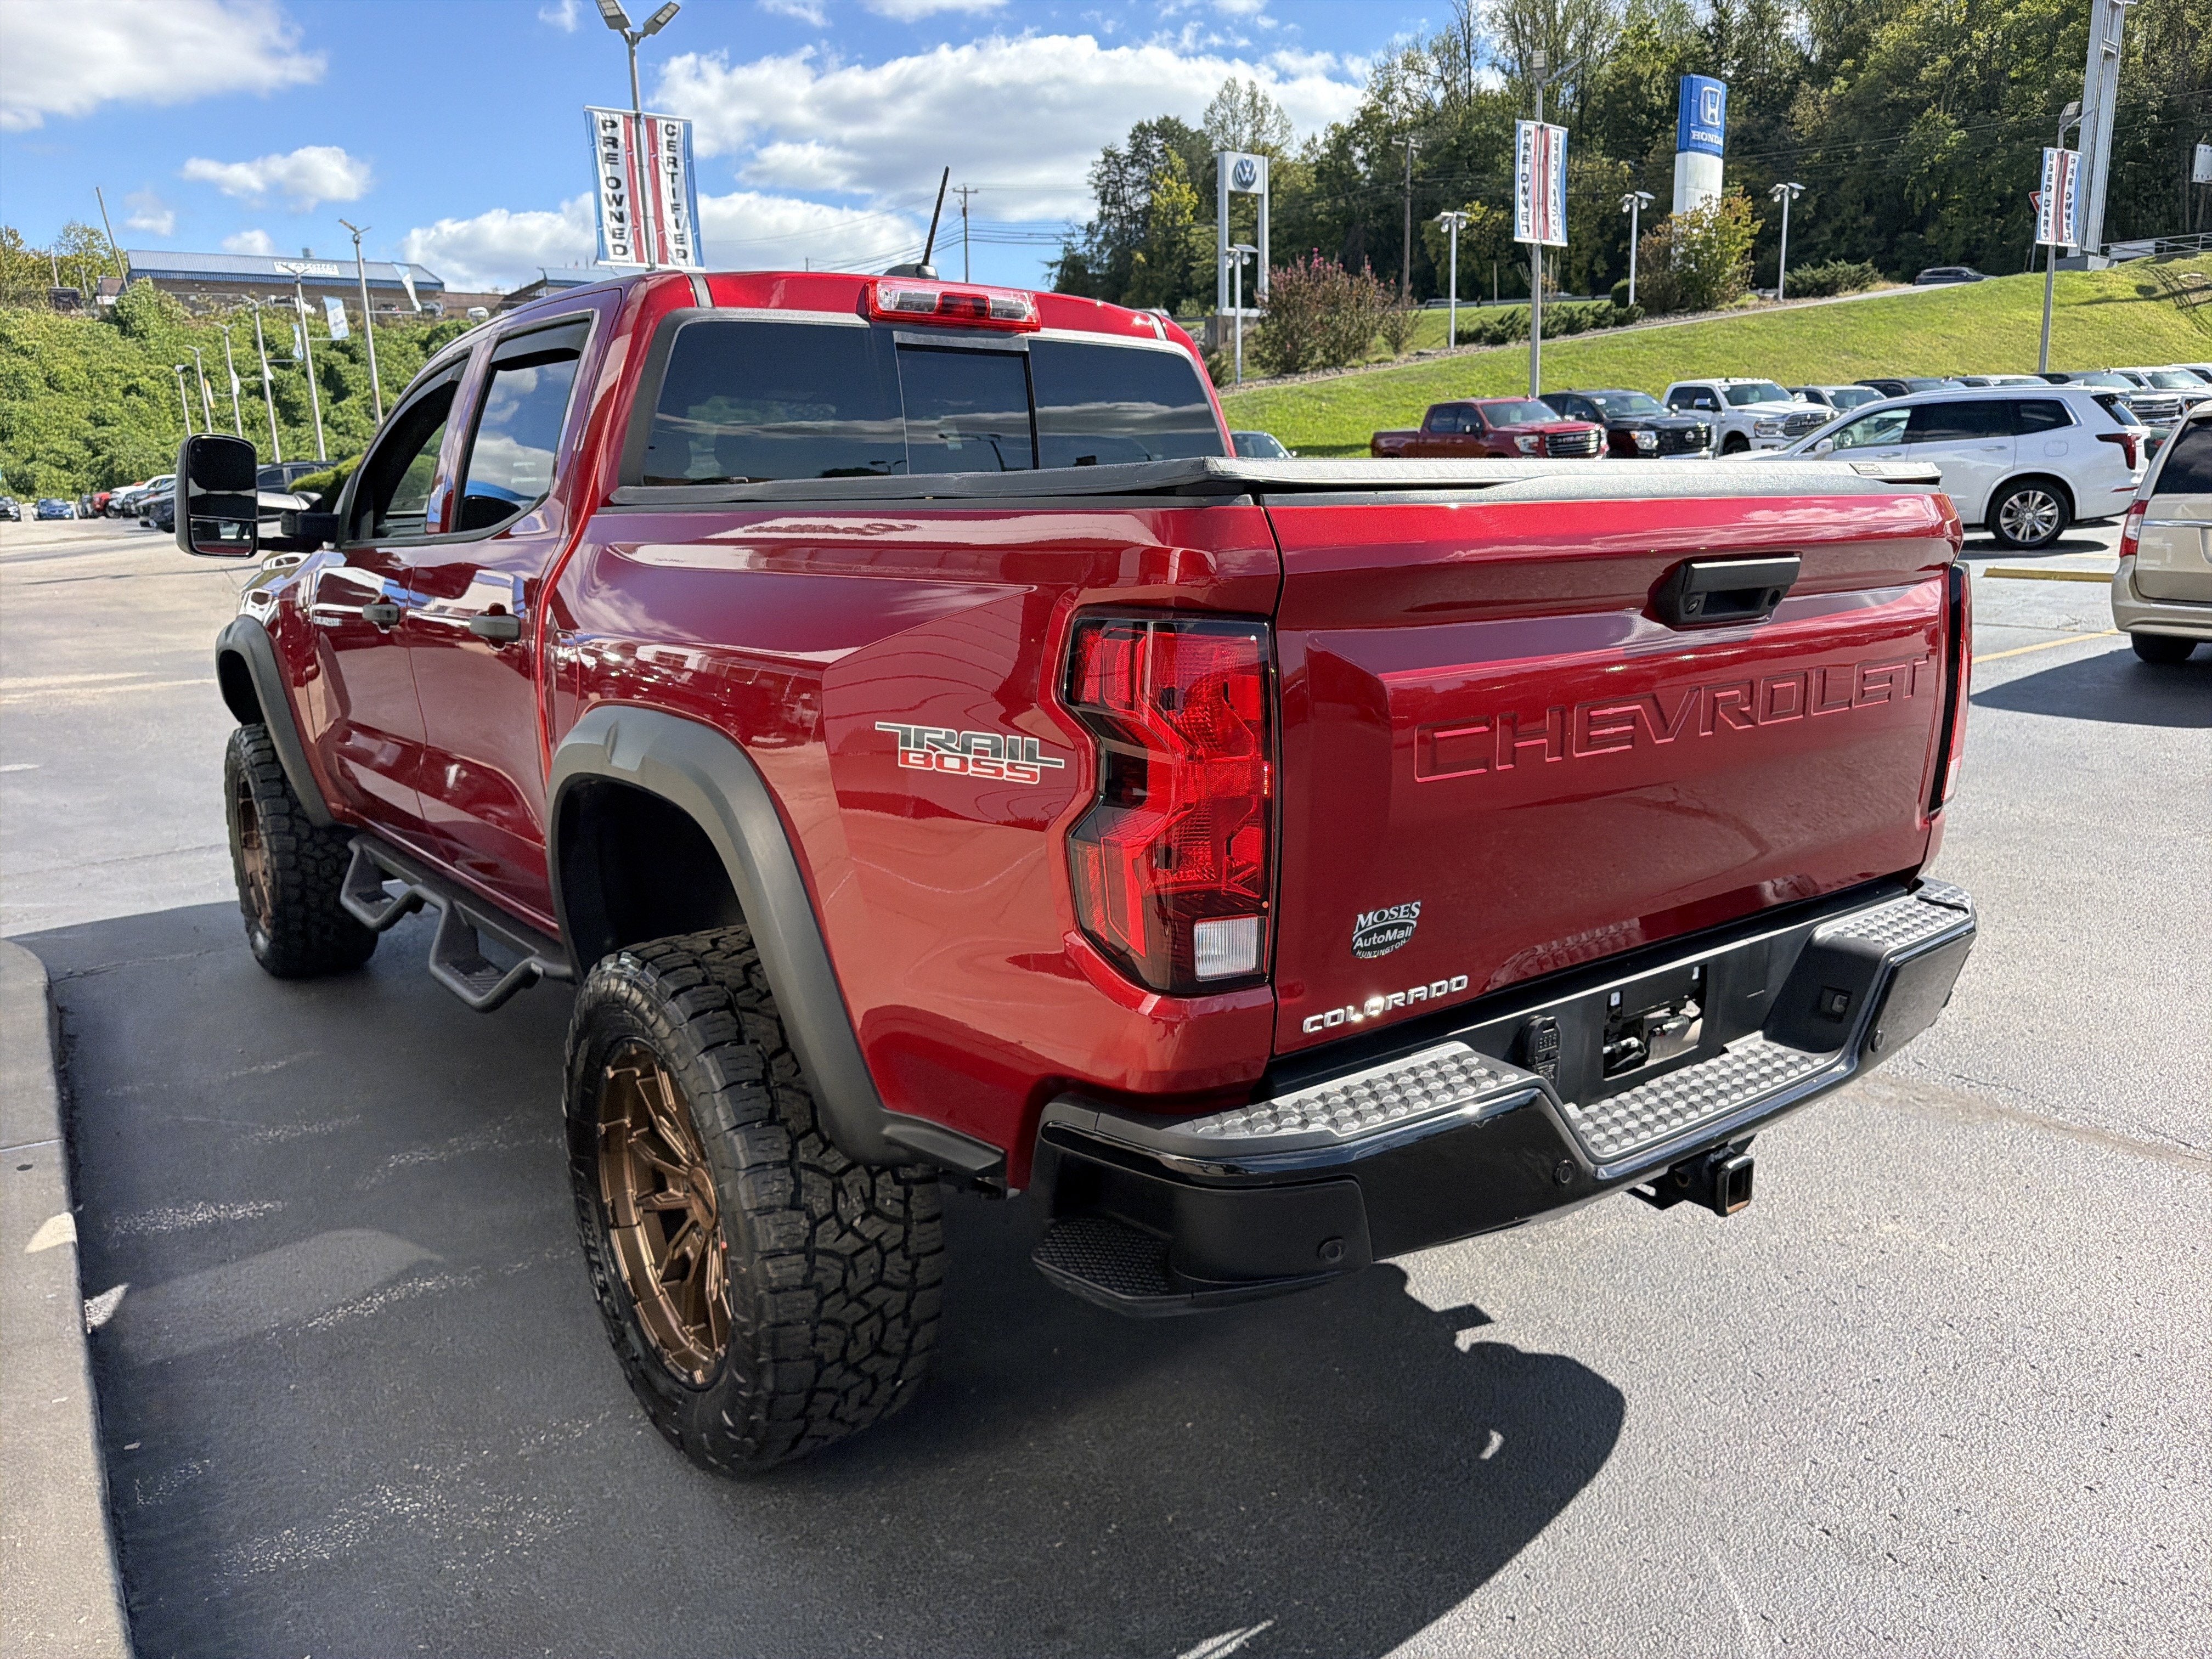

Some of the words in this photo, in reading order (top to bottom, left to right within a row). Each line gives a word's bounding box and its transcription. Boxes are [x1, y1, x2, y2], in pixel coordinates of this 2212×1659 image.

[601, 119, 619, 165] PRE
[1522, 129, 1532, 164] PRE
[664, 124, 687, 259] CERTIFIED
[2045, 153, 2054, 193] USED
[2068, 159, 2076, 185] PRE
[604, 176, 628, 256] OWNED
[1415, 658, 1928, 782] CHEVROLET
[875, 721, 1065, 769] TRAIL
[898, 749, 1040, 785] BOSS
[1353, 901, 1421, 934] MOSES
[1353, 926, 1413, 950] AutoMall
[1356, 939, 1406, 957] HUNTINGTON
[1302, 974, 1468, 1033] COLORADO
